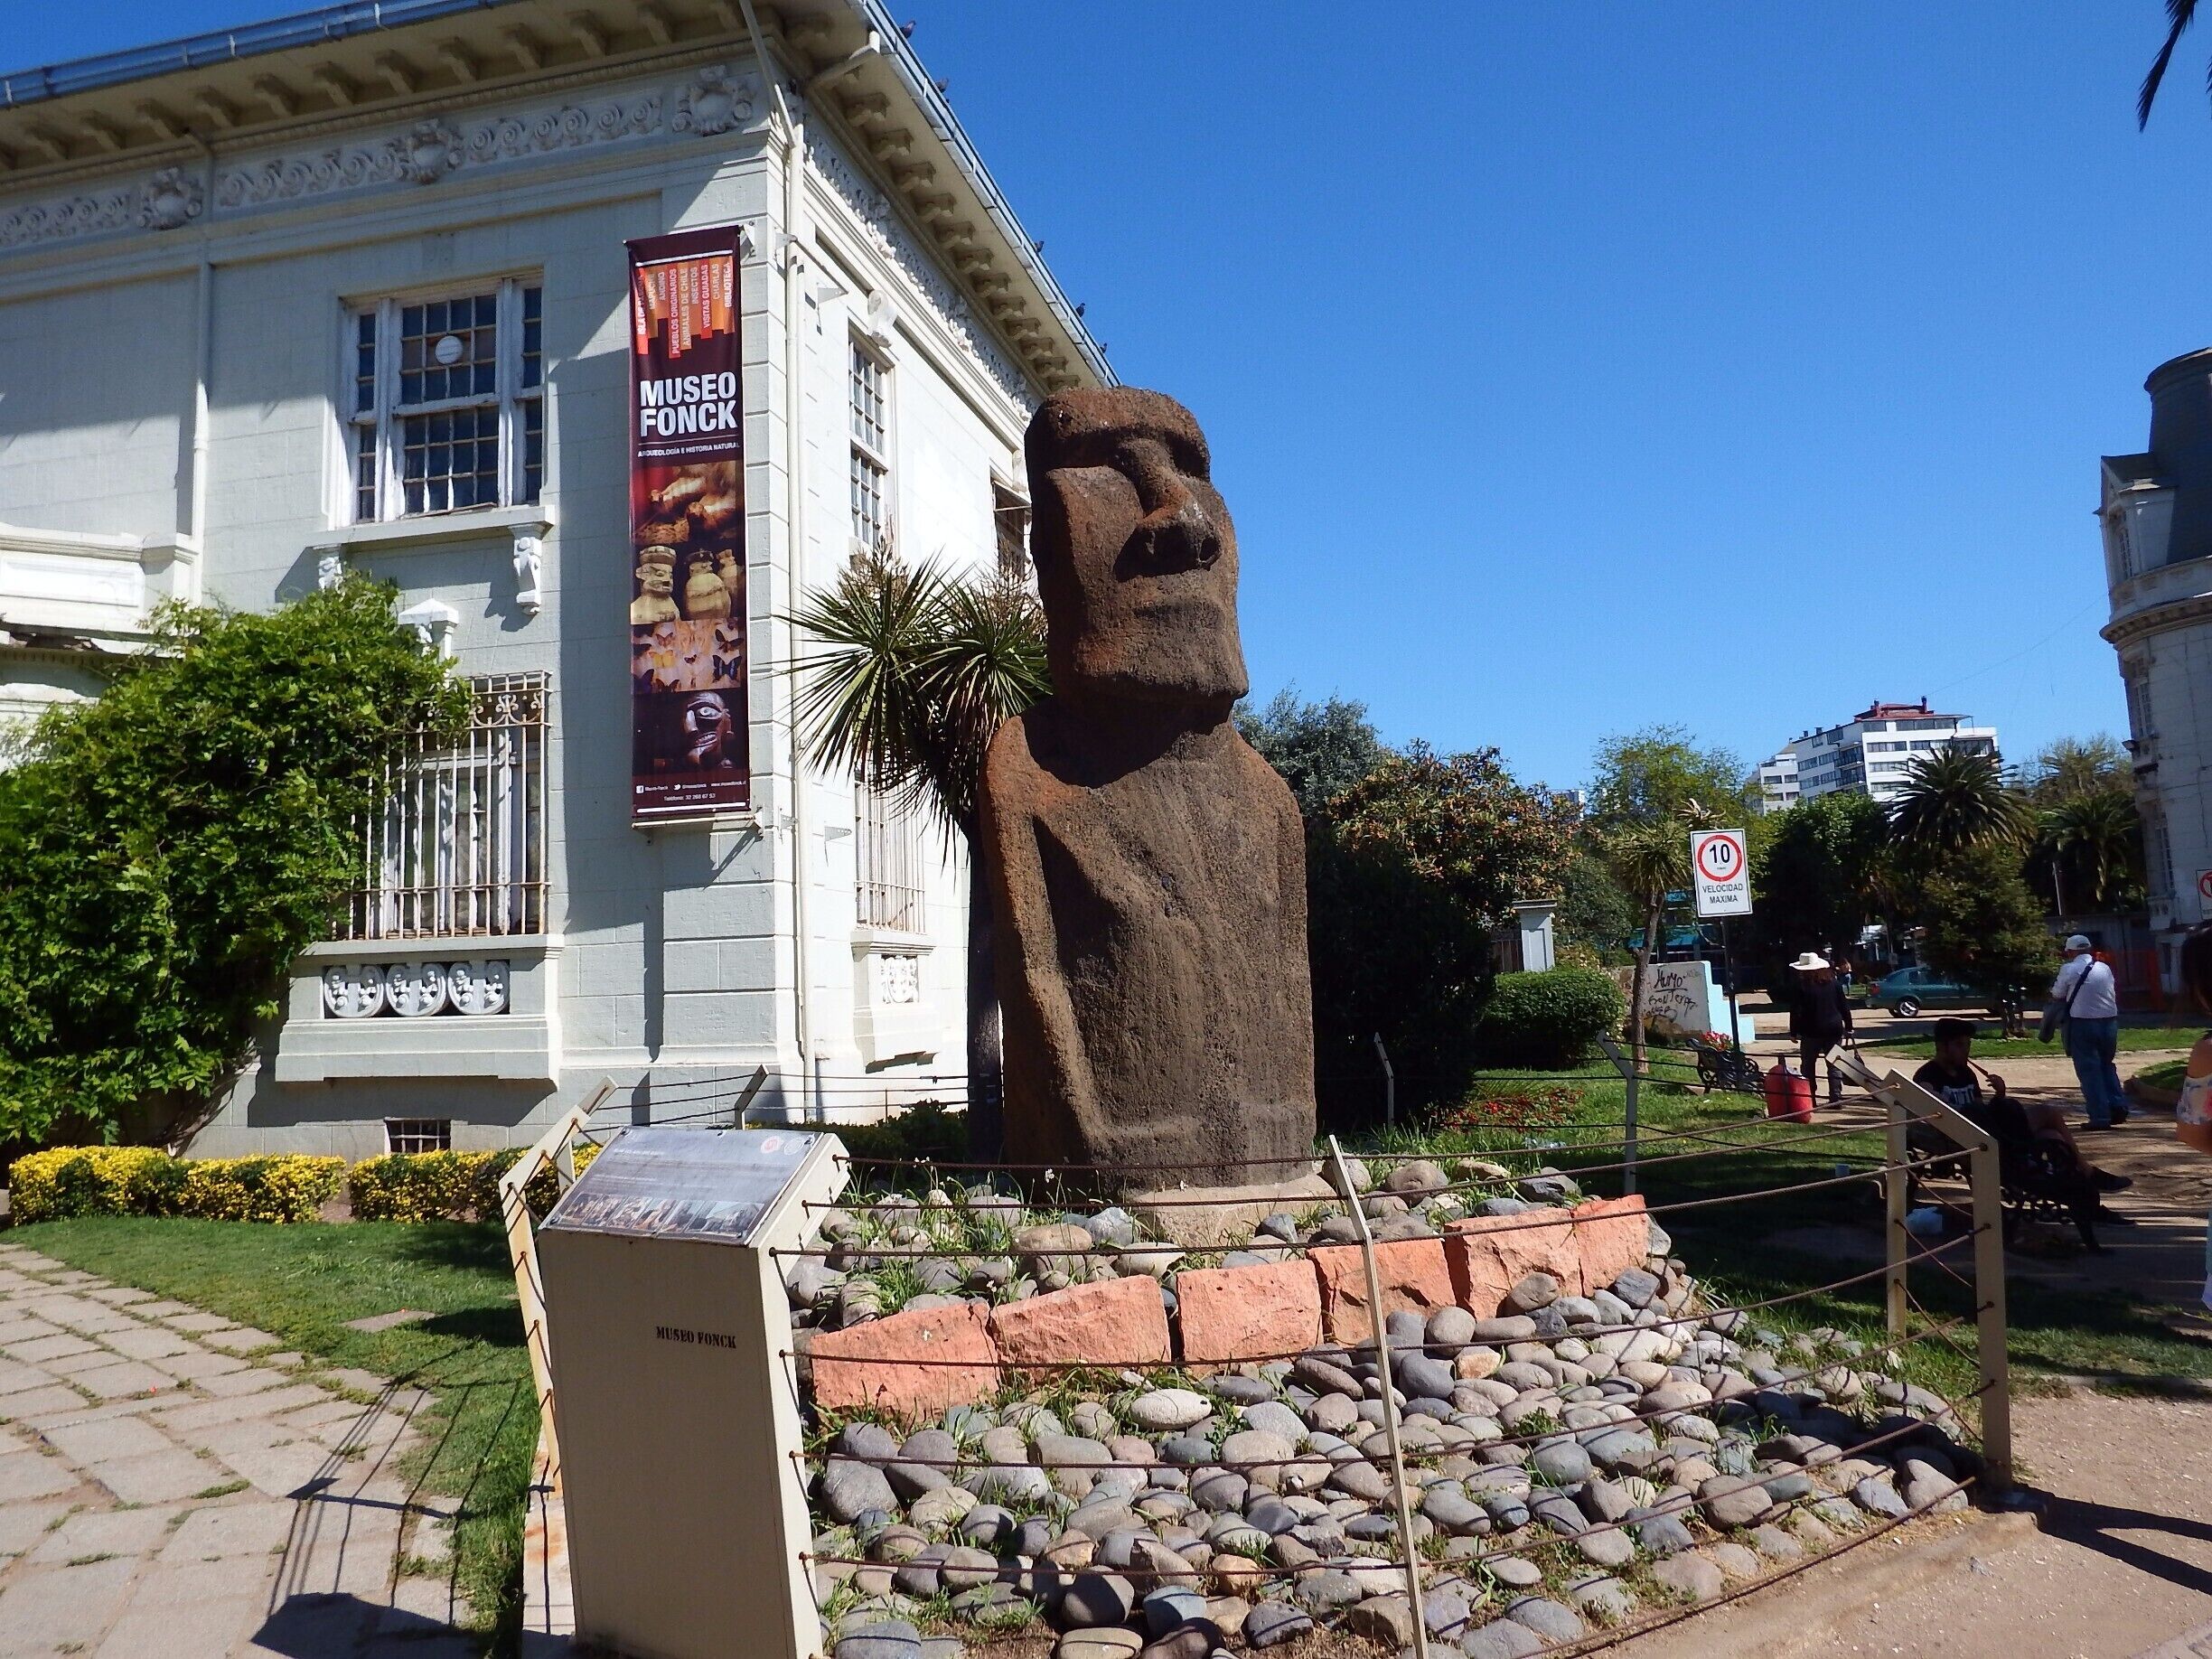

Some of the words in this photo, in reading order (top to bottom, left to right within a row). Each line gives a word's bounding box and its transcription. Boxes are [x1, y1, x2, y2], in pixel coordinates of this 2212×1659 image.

[648, 274, 656, 309] MAPUCHE
[658, 272, 666, 300] ANDINO
[670, 268, 678, 317] ORIGINARIOS
[680, 268, 688, 291] CHILE
[690, 267, 699, 305] INSECTOS
[700, 264, 709, 299] GUIADAS
[711, 263, 720, 300] CHARLAS
[724, 262, 732, 307] BIBLIOTECA
[680, 293, 689, 305] DE
[702, 300, 711, 328] VISITAS
[637, 318, 646, 334] ISLA
[671, 319, 680, 354] PUEBLOS
[681, 306, 691, 346] ANIMALES
[640, 371, 736, 407] MUSEO
[640, 400, 738, 437] FONCK
[686, 444, 713, 455] HISTORIA
[713, 442, 740, 451] NATURAL
[1710, 843, 1730, 863] 10
[1702, 883, 1743, 893] VELOCIDAD
[1709, 895, 1738, 904] MAXIMA
[656, 1326, 695, 1344] MUSEO
[698, 1331, 736, 1349] FONCK
